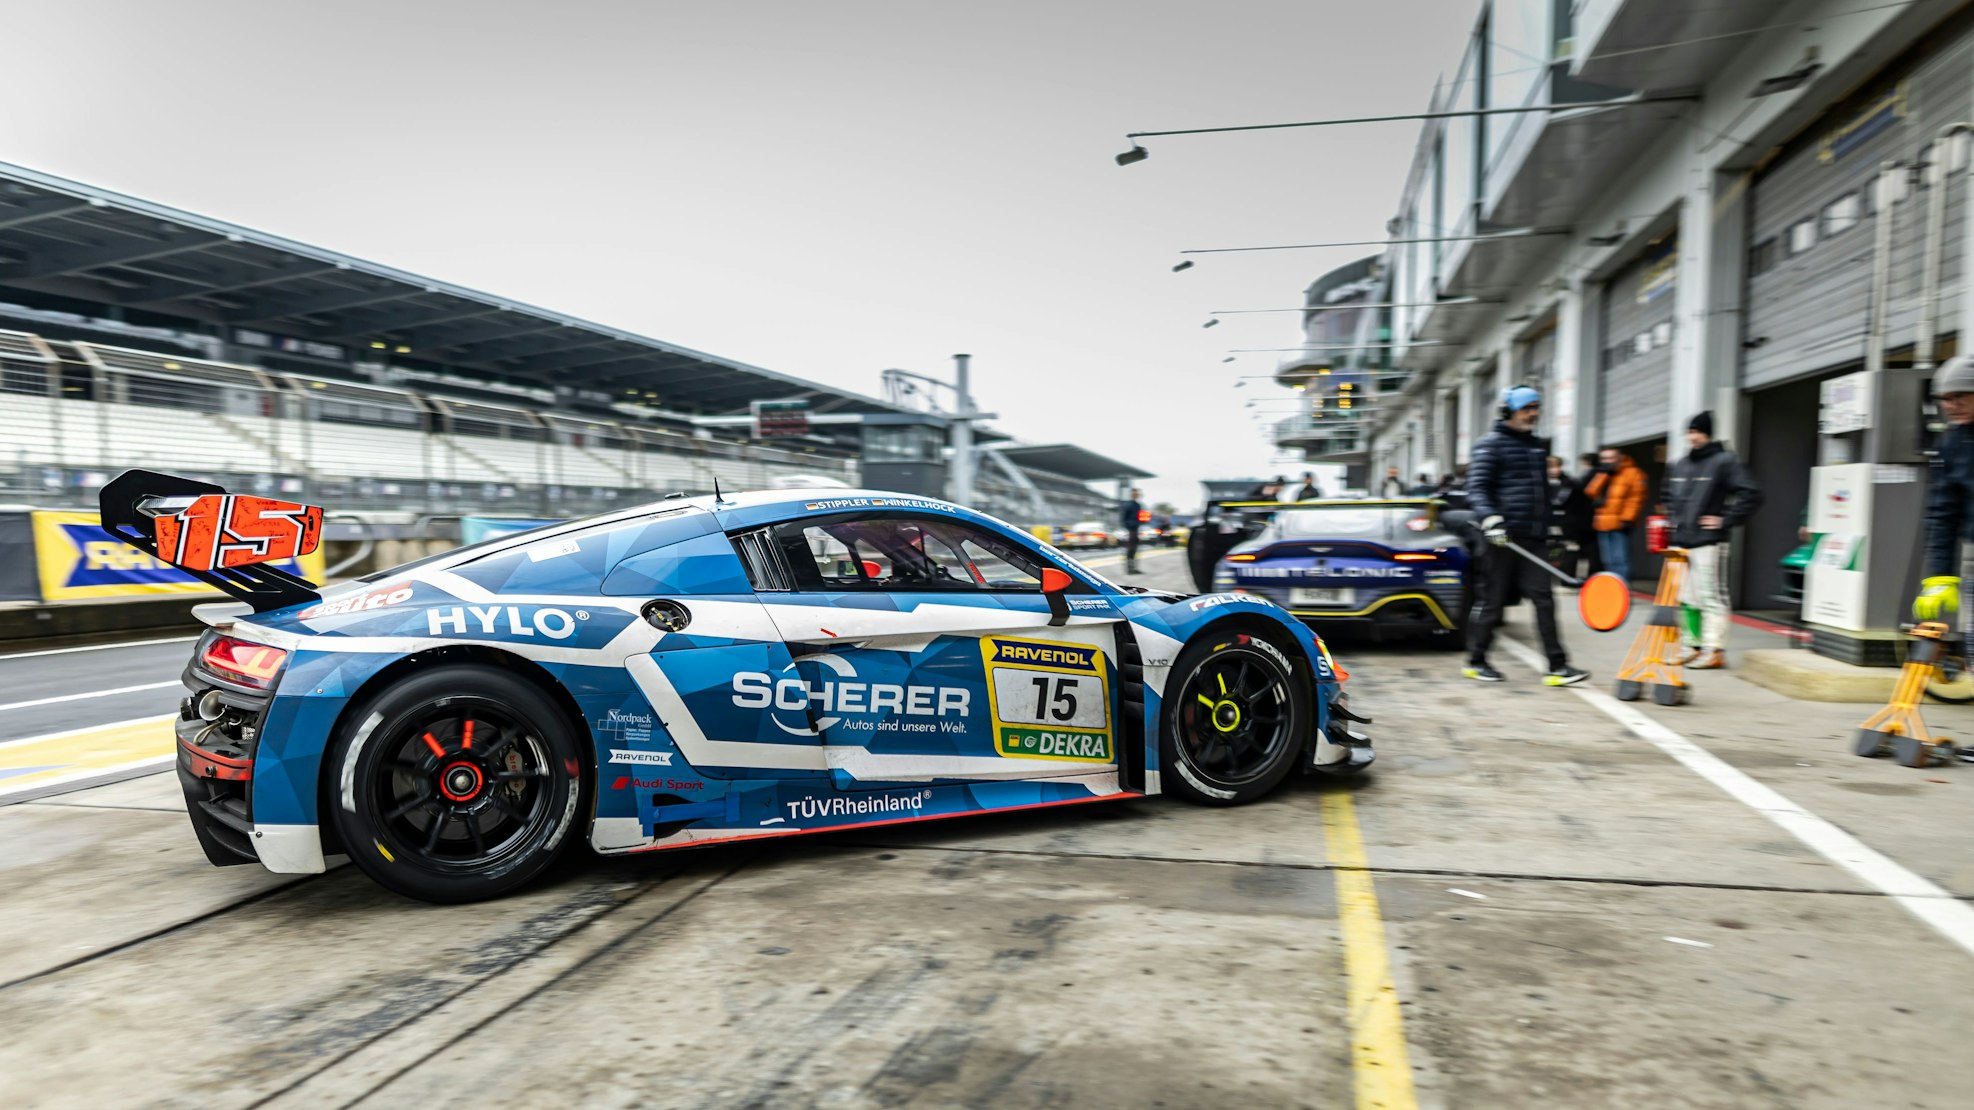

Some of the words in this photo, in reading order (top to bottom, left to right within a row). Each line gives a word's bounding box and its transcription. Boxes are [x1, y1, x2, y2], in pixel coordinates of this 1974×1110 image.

[818, 499, 869, 509] STIPPLER
[883, 499, 957, 514] WINKELHOCK
[176, 495, 307, 570] 15
[1001, 645, 1089, 666] RAVENOL
[1147, 658, 1169, 666] V10
[731, 671, 971, 717] SCHERER
[1032, 677, 1079, 721] 15
[607, 710, 652, 724] Nordpack
[843, 718, 874, 731] Autos
[877, 718, 899, 731] sind
[901, 721, 936, 733] unsere
[940, 720, 968, 734] Welt.
[1039, 732, 1106, 757] DEKRA
[615, 753, 666, 762] RAVENOL
[631, 778, 662, 789] Audi
[666, 778, 705, 791] Sport
